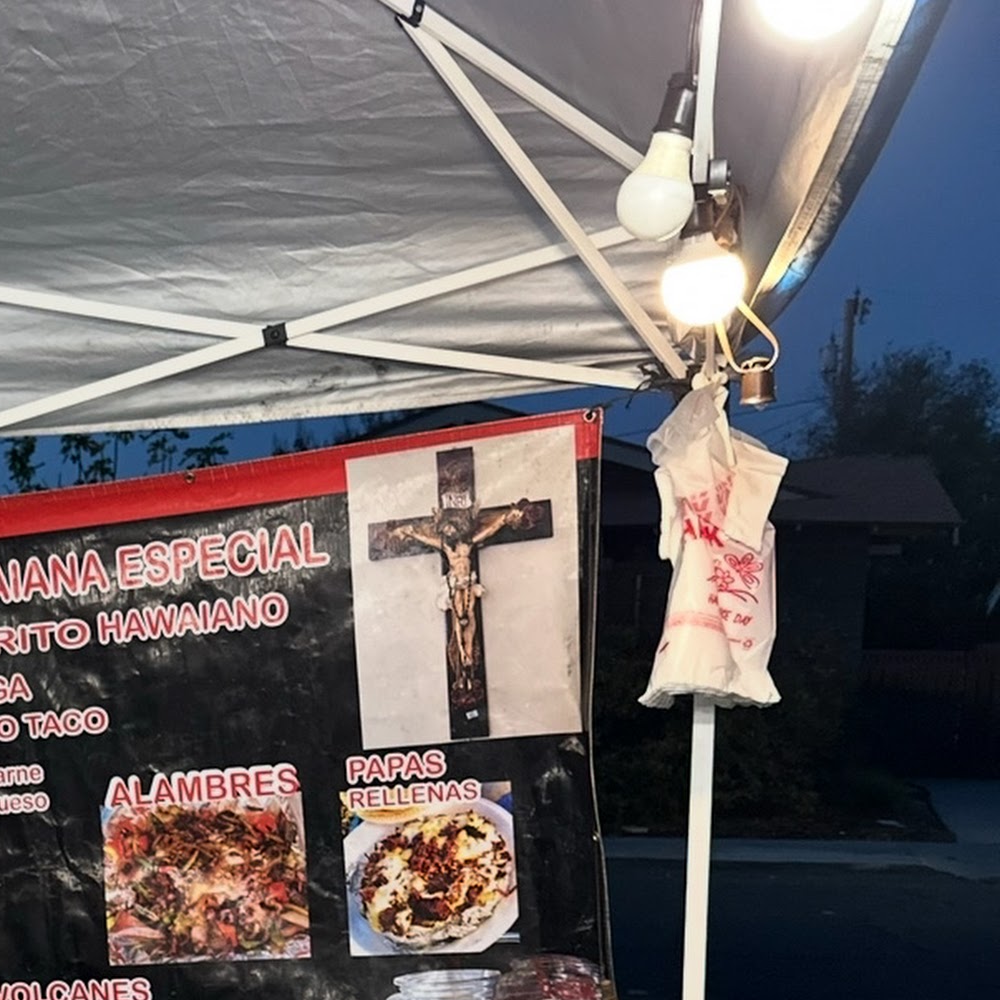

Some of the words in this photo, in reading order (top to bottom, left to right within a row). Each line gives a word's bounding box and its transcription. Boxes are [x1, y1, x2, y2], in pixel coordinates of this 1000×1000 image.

[116, 522, 330, 589] ESPECIAL
[97, 592, 288, 645] HAWAIANO
[22, 706, 109, 738] TACO
[106, 763, 300, 808] ALAMBRES
[346, 749, 446, 784] PAPAS
[347, 778, 481, 809] RELLENAS
